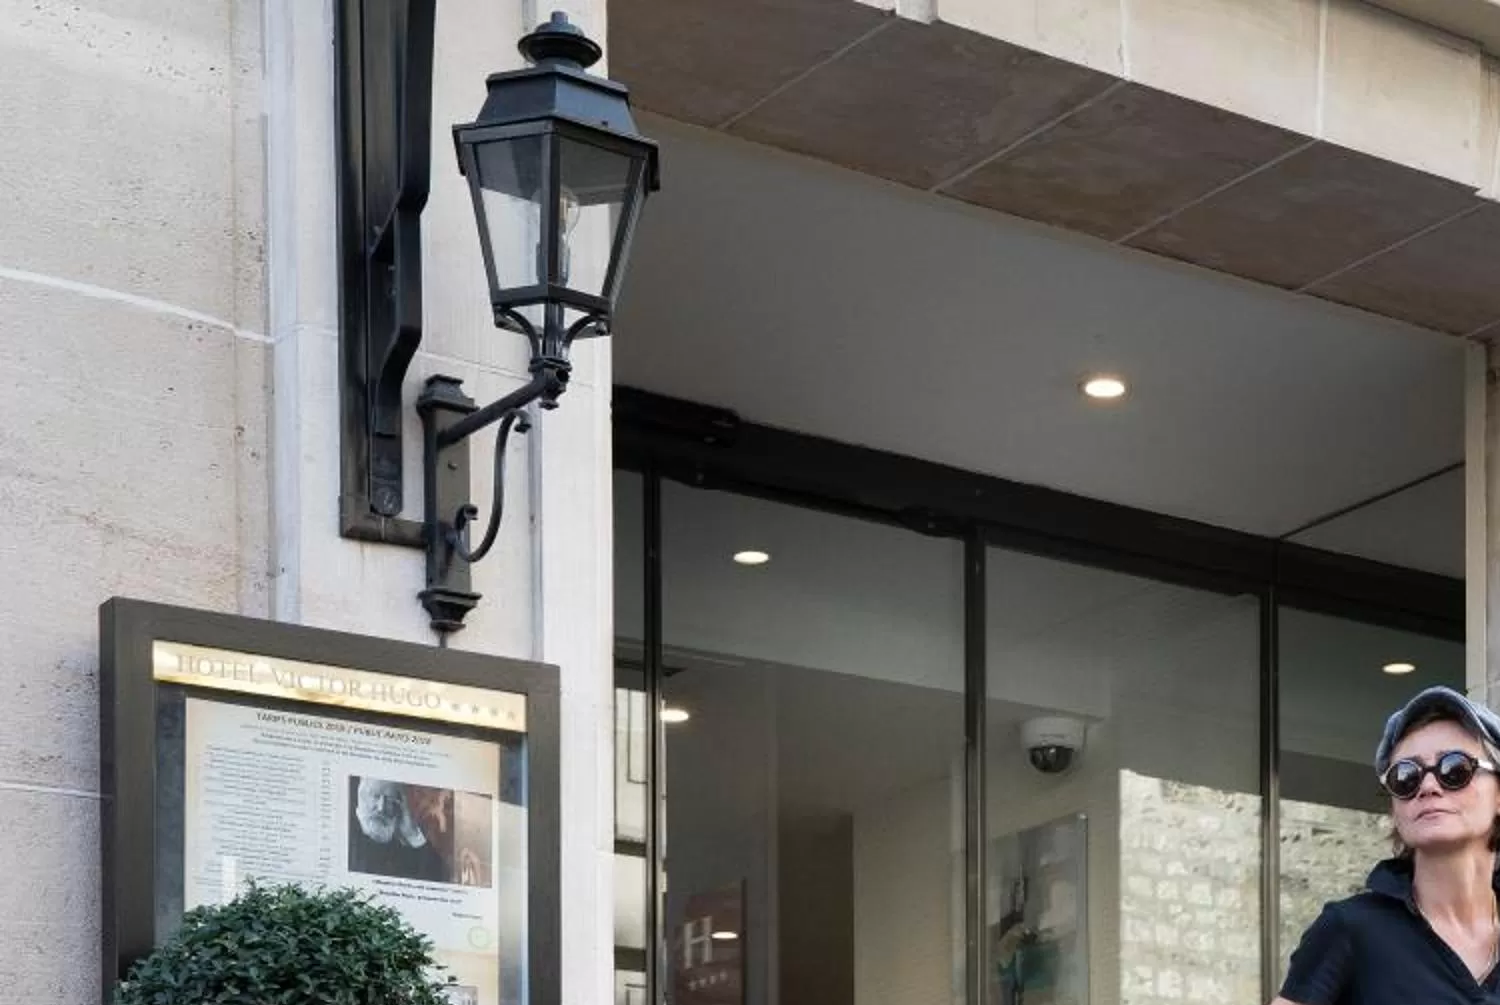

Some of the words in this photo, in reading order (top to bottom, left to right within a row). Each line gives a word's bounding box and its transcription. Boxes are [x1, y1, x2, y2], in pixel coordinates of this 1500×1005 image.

[175, 654, 256, 684] HOTEL
[270, 667, 366, 698] VICTOR
[371, 679, 442, 710] HUGO
